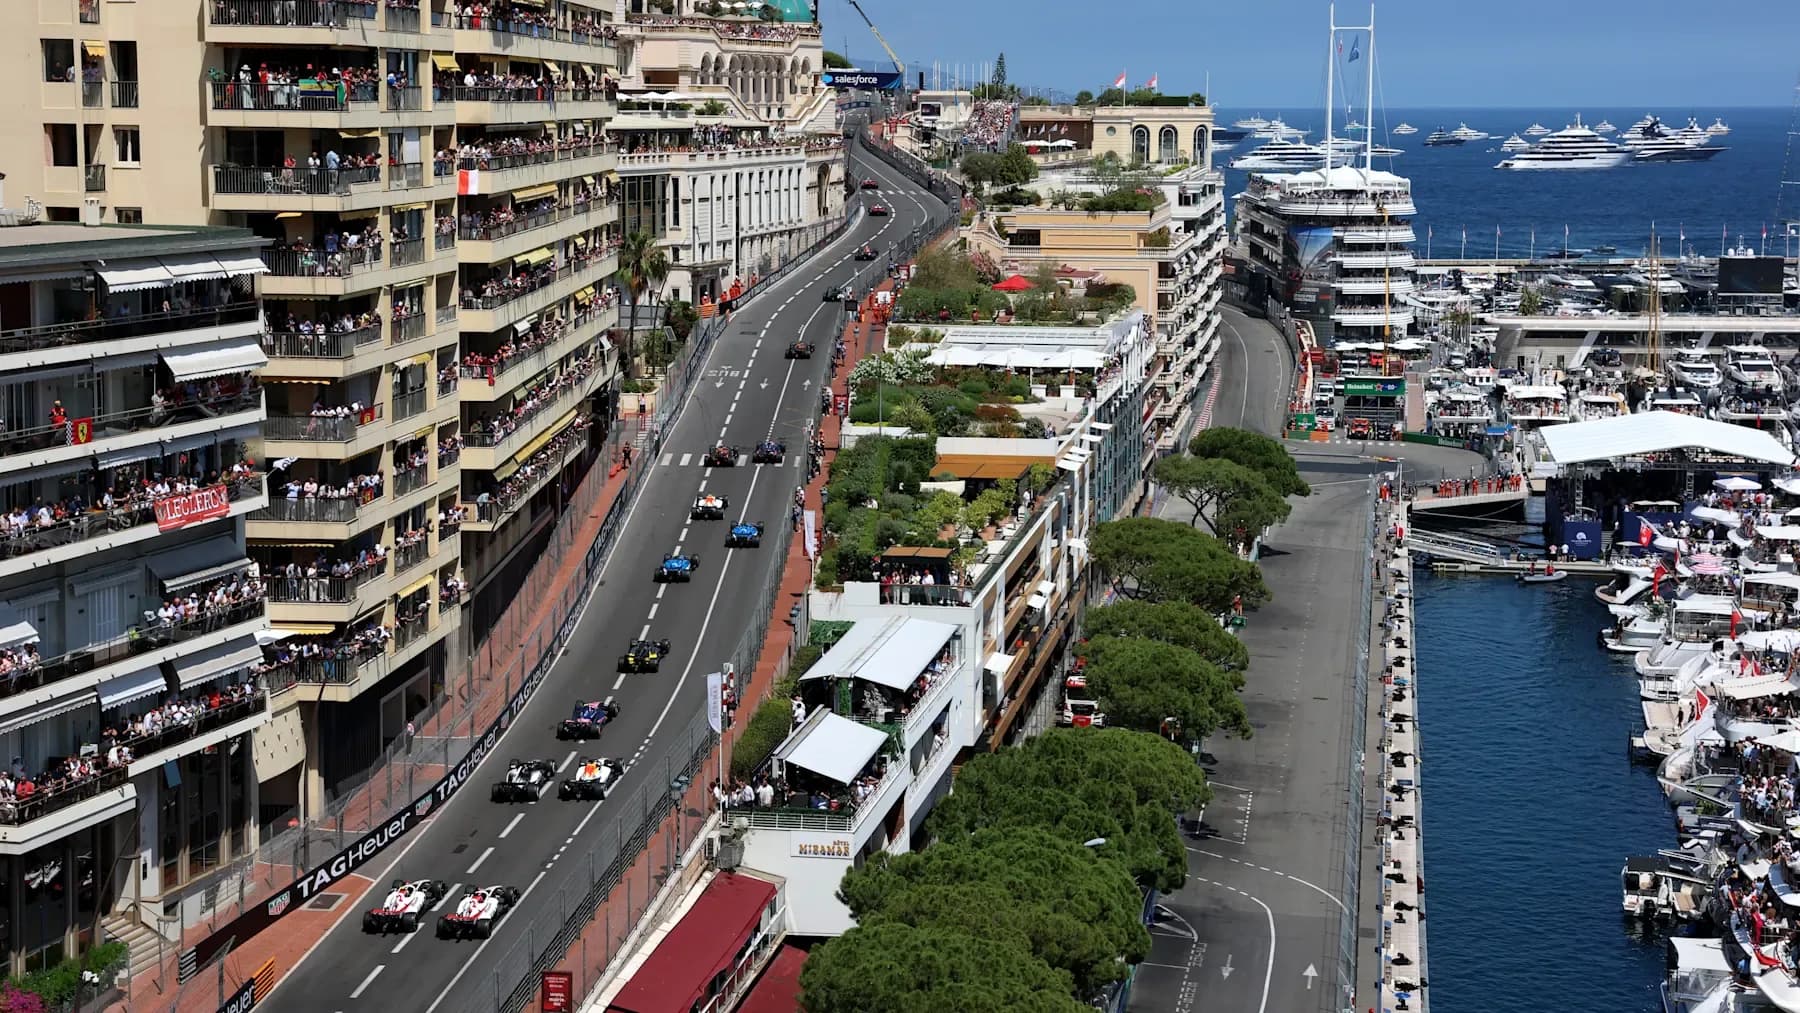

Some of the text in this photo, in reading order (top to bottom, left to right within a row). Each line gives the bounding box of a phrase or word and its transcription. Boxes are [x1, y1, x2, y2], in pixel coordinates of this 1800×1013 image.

[834, 74, 878, 86] salesforce
[165, 489, 219, 520] LECLERC
[799, 843, 850, 857] MIRAMAR
